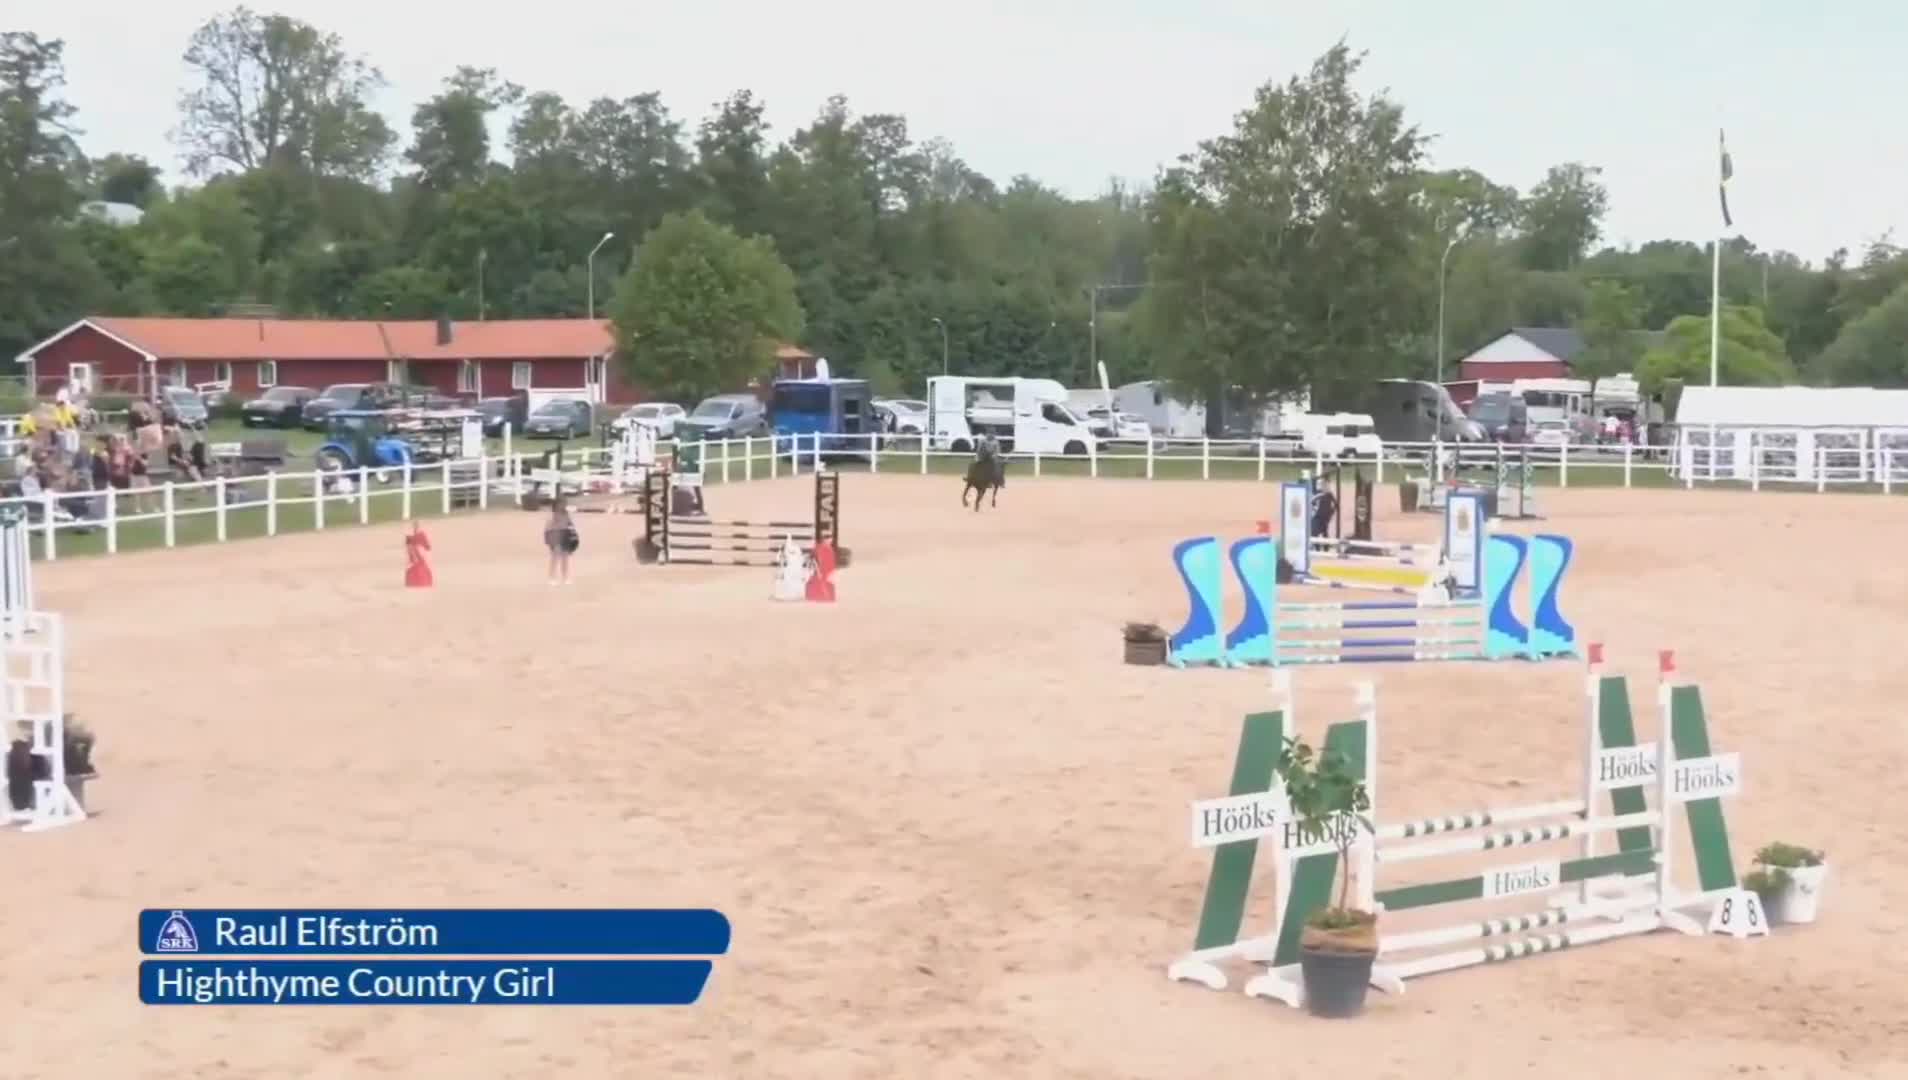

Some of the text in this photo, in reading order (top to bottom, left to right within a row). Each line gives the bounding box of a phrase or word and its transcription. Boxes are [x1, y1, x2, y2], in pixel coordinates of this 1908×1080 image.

[1600, 751, 1656, 781] Hööks
[1674, 763, 1734, 793] Hööks
[1203, 801, 1276, 837] Hööks
[1495, 866, 1551, 896] Hööks
[1721, 897, 1732, 926] 8
[1747, 898, 1758, 927] 8
